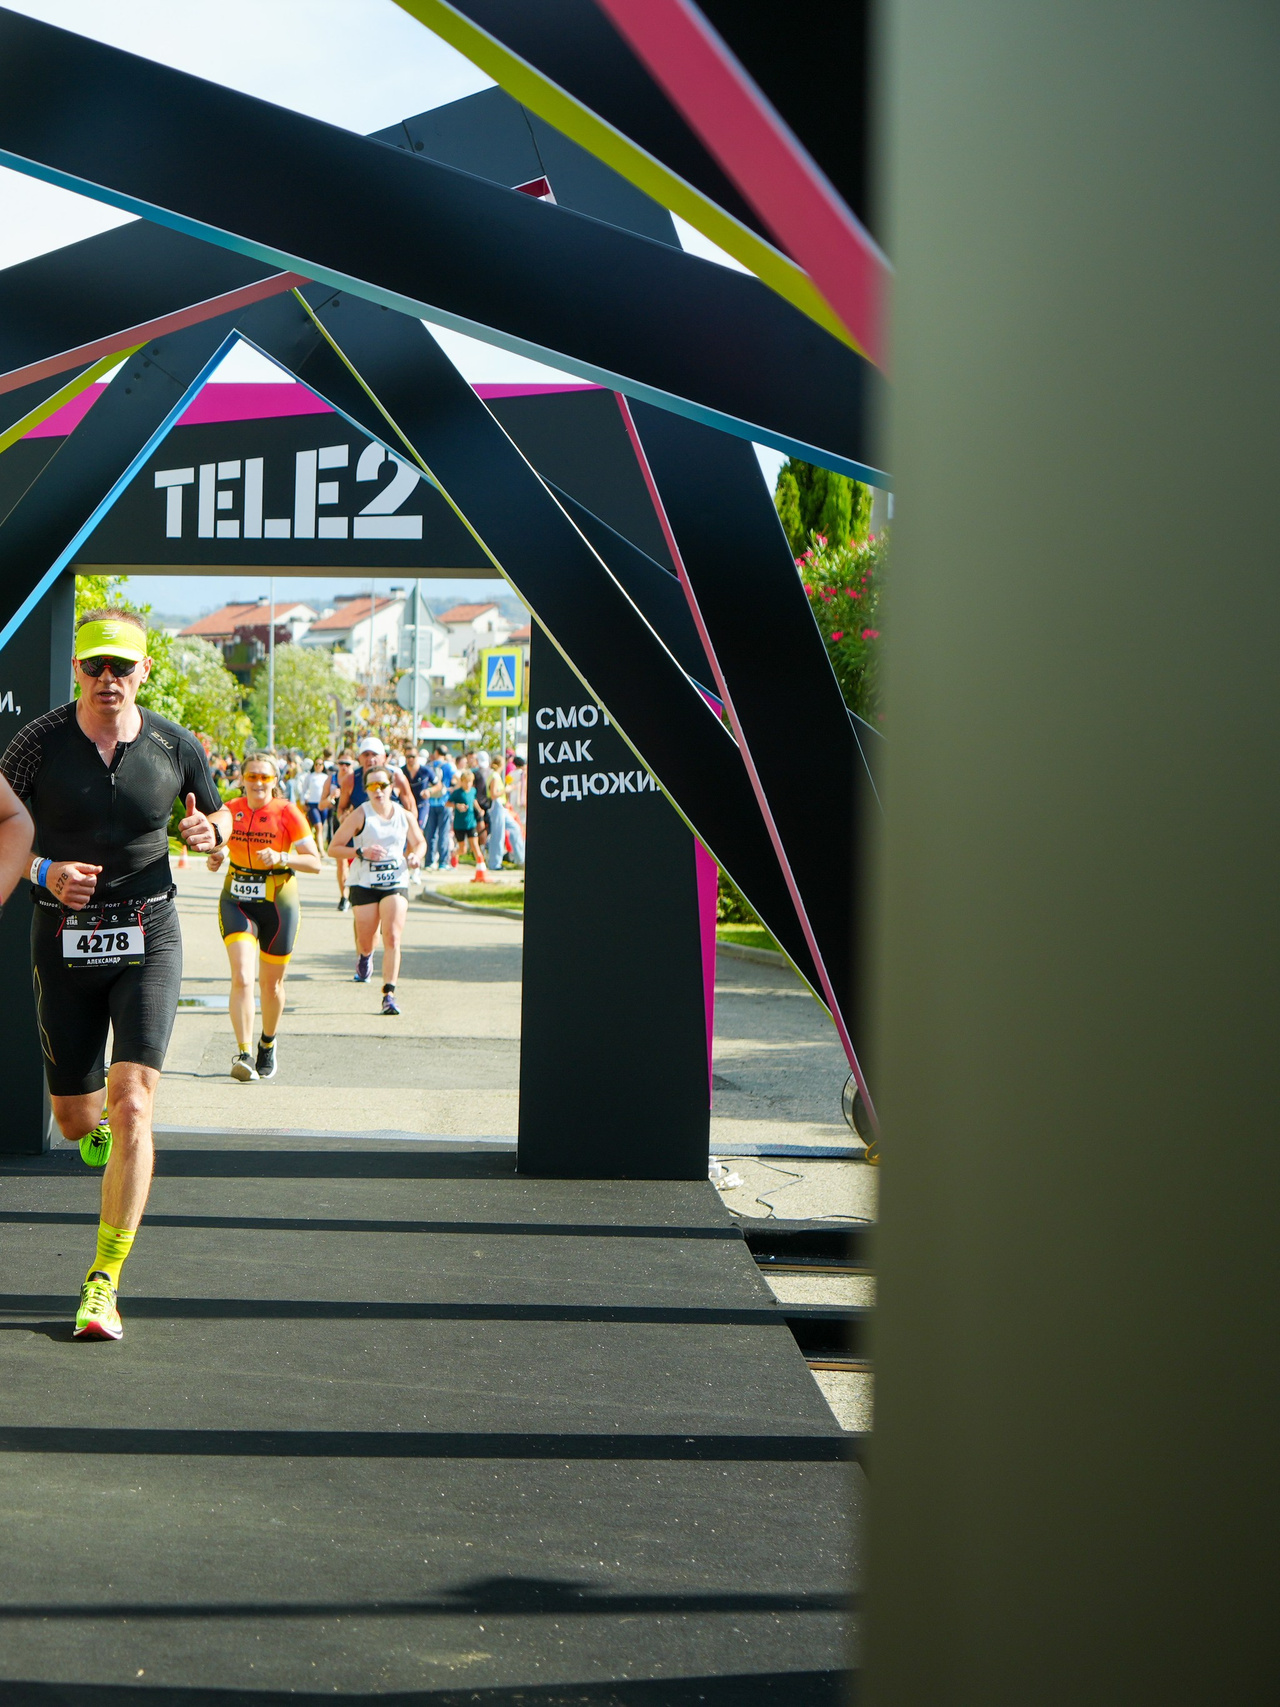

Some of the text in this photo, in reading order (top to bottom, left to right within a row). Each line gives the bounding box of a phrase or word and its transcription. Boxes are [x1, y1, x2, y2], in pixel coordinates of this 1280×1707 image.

[154, 441, 423, 539] TELE2
[538, 739, 594, 766] КАК
[540, 770, 662, 803] СДЮЖИ
[234, 884, 259, 895] 4494
[76, 931, 129, 953] 4278
[86, 956, 121, 965] АЛЕКСАНДР
